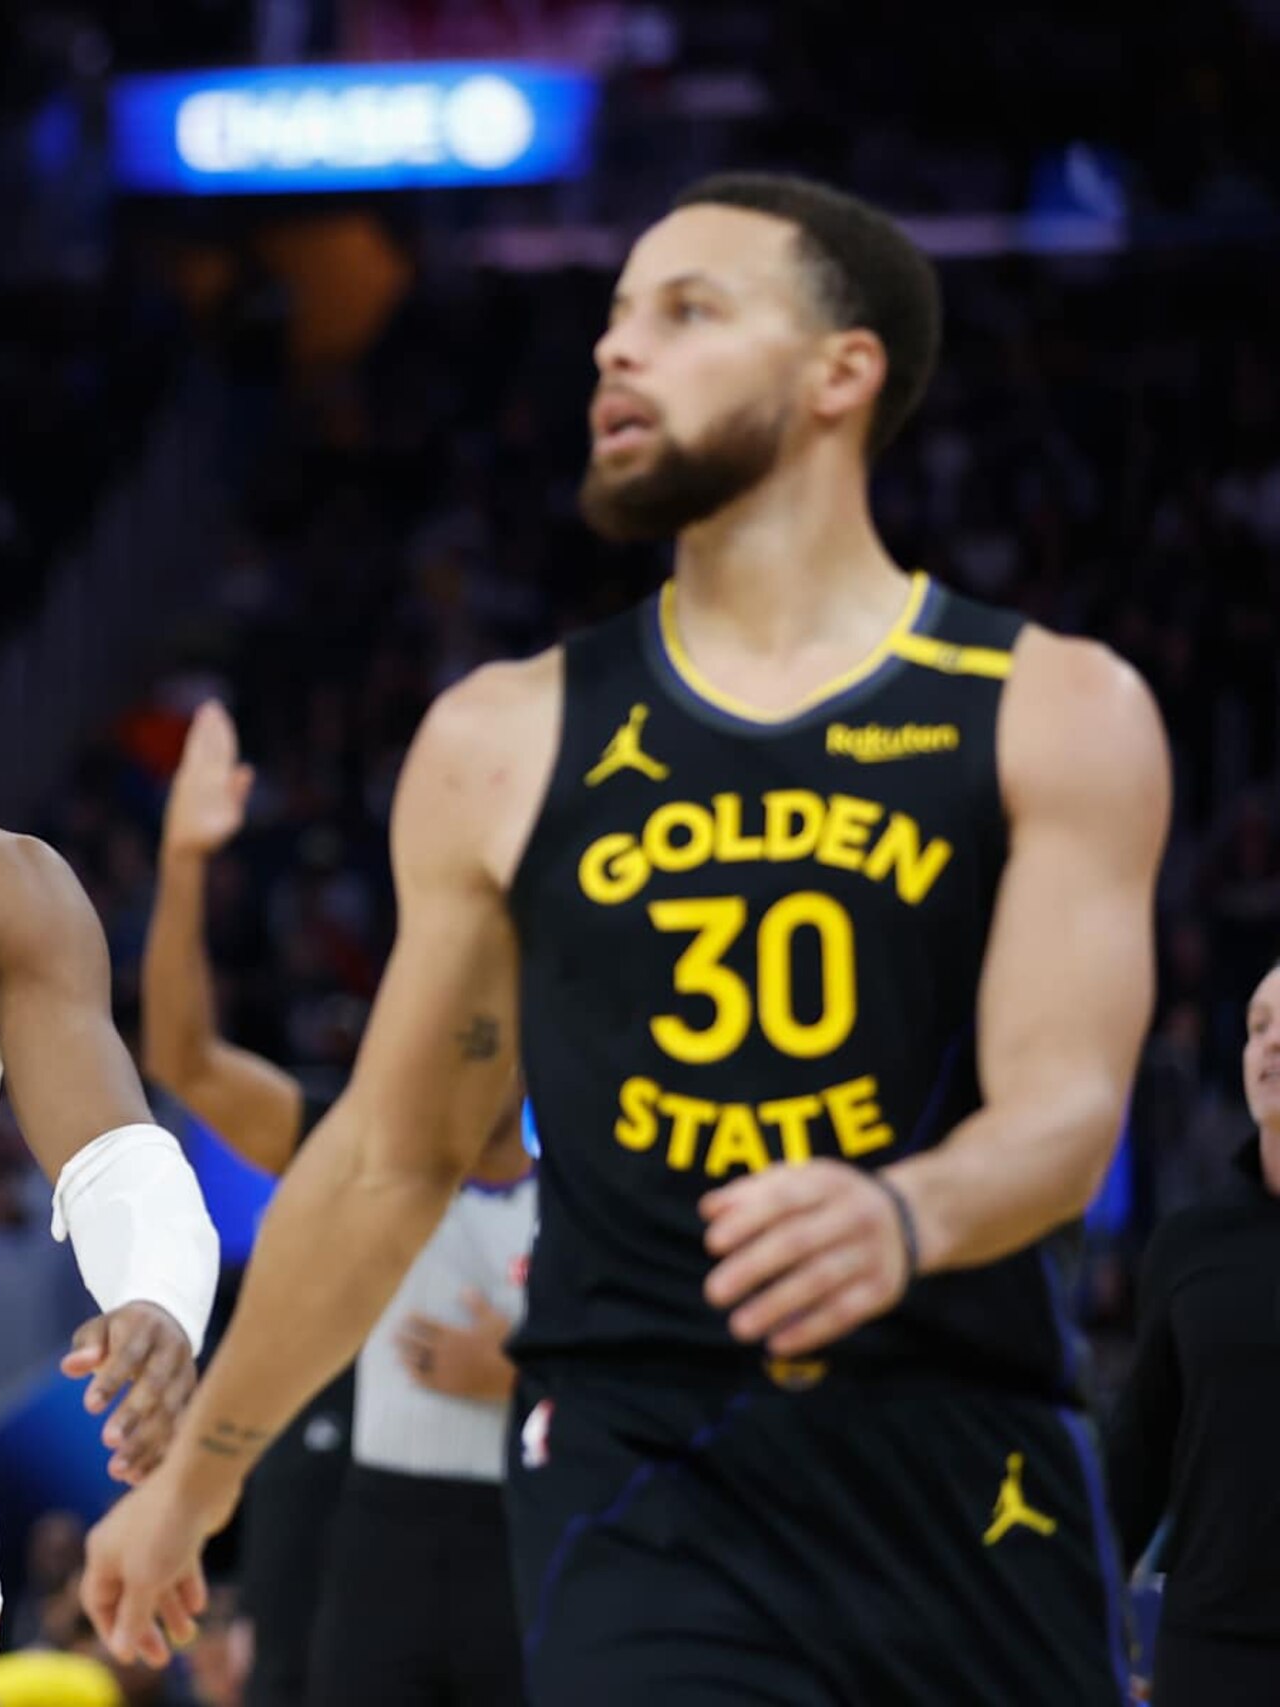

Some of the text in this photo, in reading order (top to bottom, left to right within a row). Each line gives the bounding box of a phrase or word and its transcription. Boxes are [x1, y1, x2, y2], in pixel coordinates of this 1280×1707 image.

[578, 789, 953, 904] GOLDEN
[647, 891, 856, 1064] 30
[615, 1075, 894, 1177] STATE
